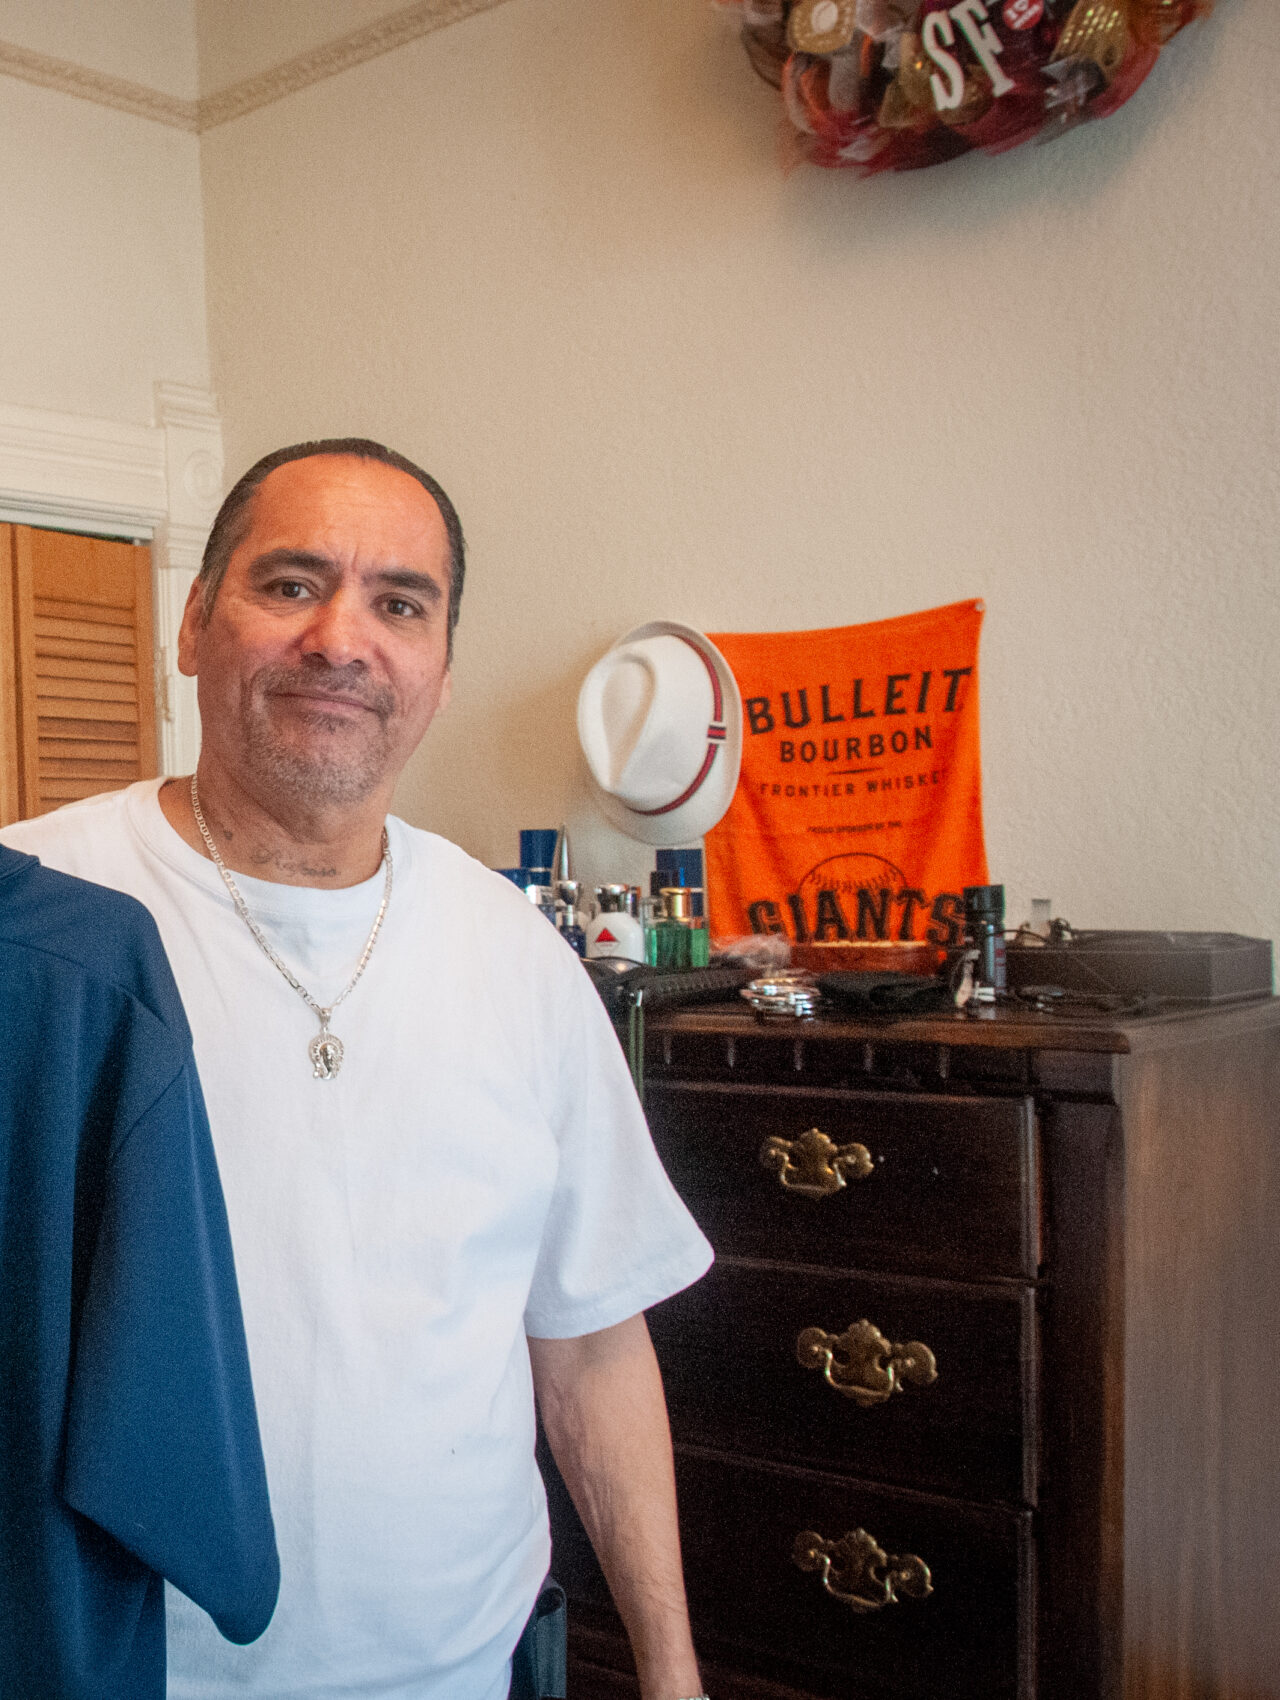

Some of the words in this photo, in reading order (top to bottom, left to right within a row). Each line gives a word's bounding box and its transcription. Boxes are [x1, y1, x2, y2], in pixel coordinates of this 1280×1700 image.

[921, 0, 1016, 111] SF
[745, 667, 974, 735] BULLEIT
[780, 725, 933, 763] BOURBON
[760, 782, 856, 798] FRONTIER
[747, 887, 966, 948] GIANTS
